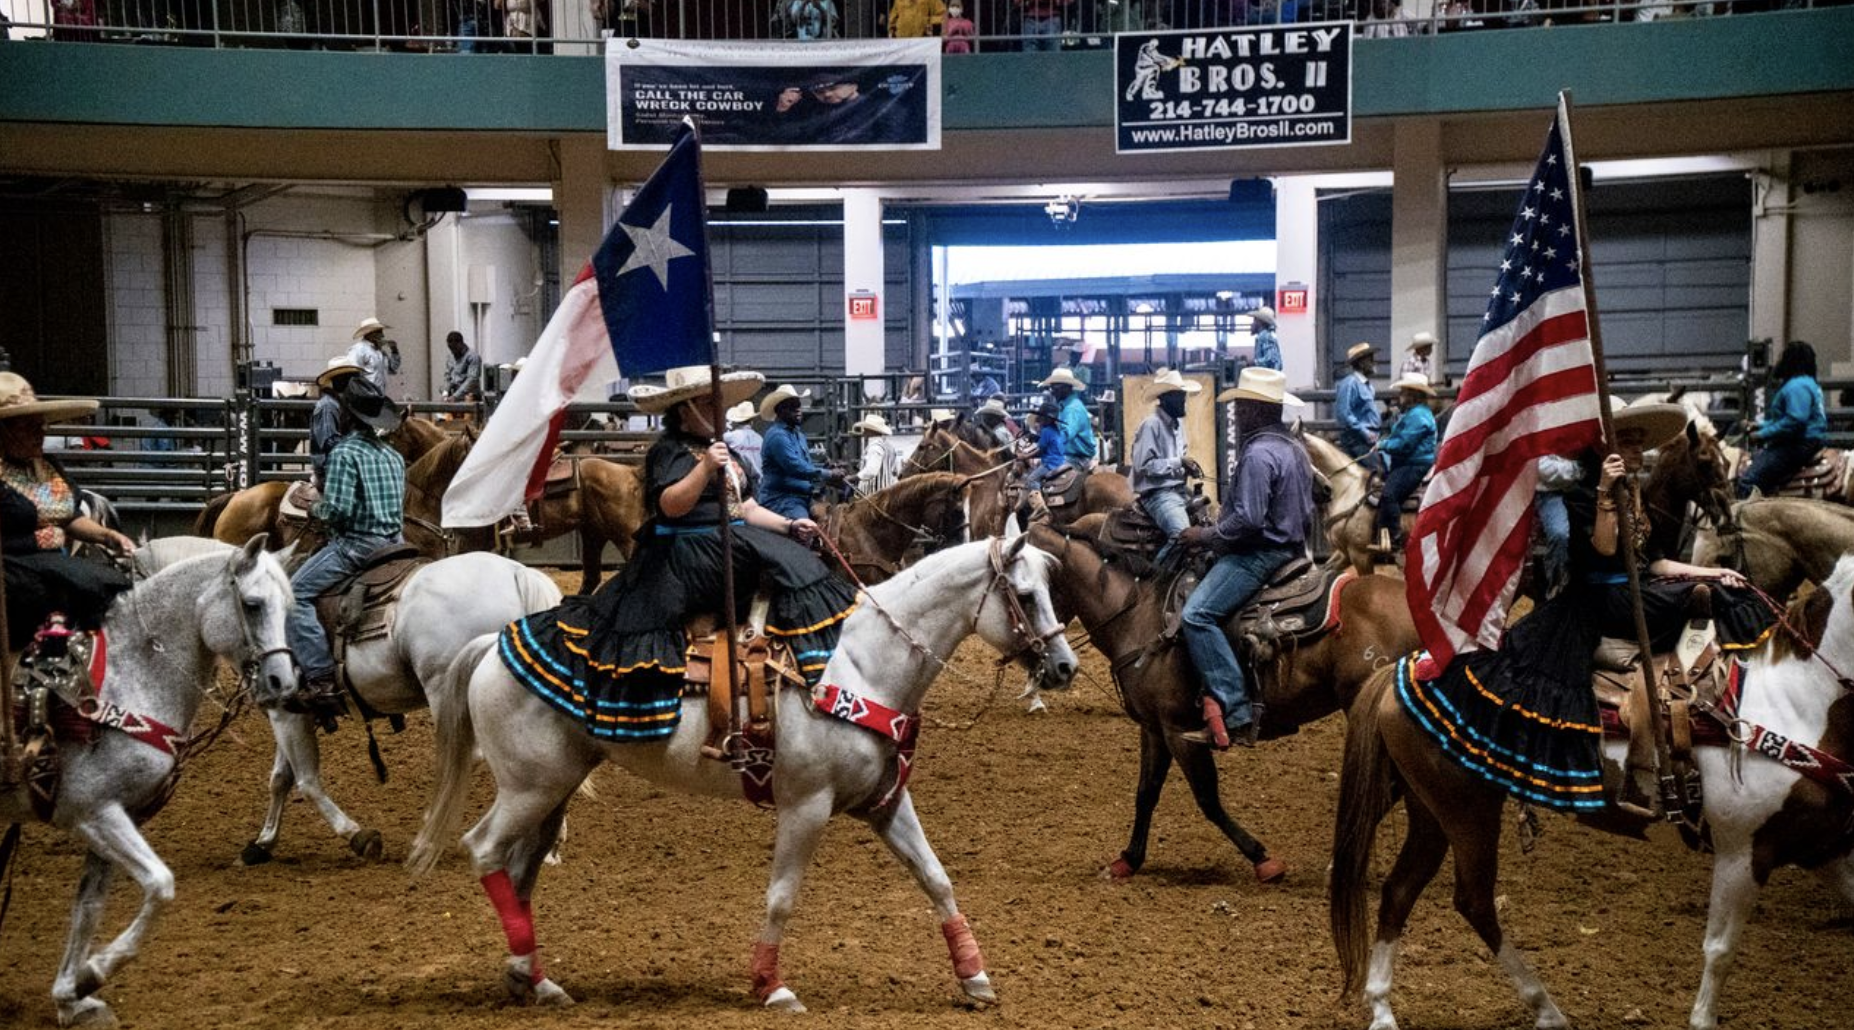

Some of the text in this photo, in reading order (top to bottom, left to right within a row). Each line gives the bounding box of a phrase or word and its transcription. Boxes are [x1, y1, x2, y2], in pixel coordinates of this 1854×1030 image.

[1182, 28, 1341, 59] HATLEY
[1180, 61, 1327, 93] BROS. II
[635, 90, 744, 101] CALL THE CAR
[635, 100, 764, 111] WRECK COWBOY
[1149, 94, 1315, 119] 214-744-1700
[853, 300, 871, 315] EXIT
[1284, 291, 1304, 307] EXIT
[239, 459, 248, 491] RO
